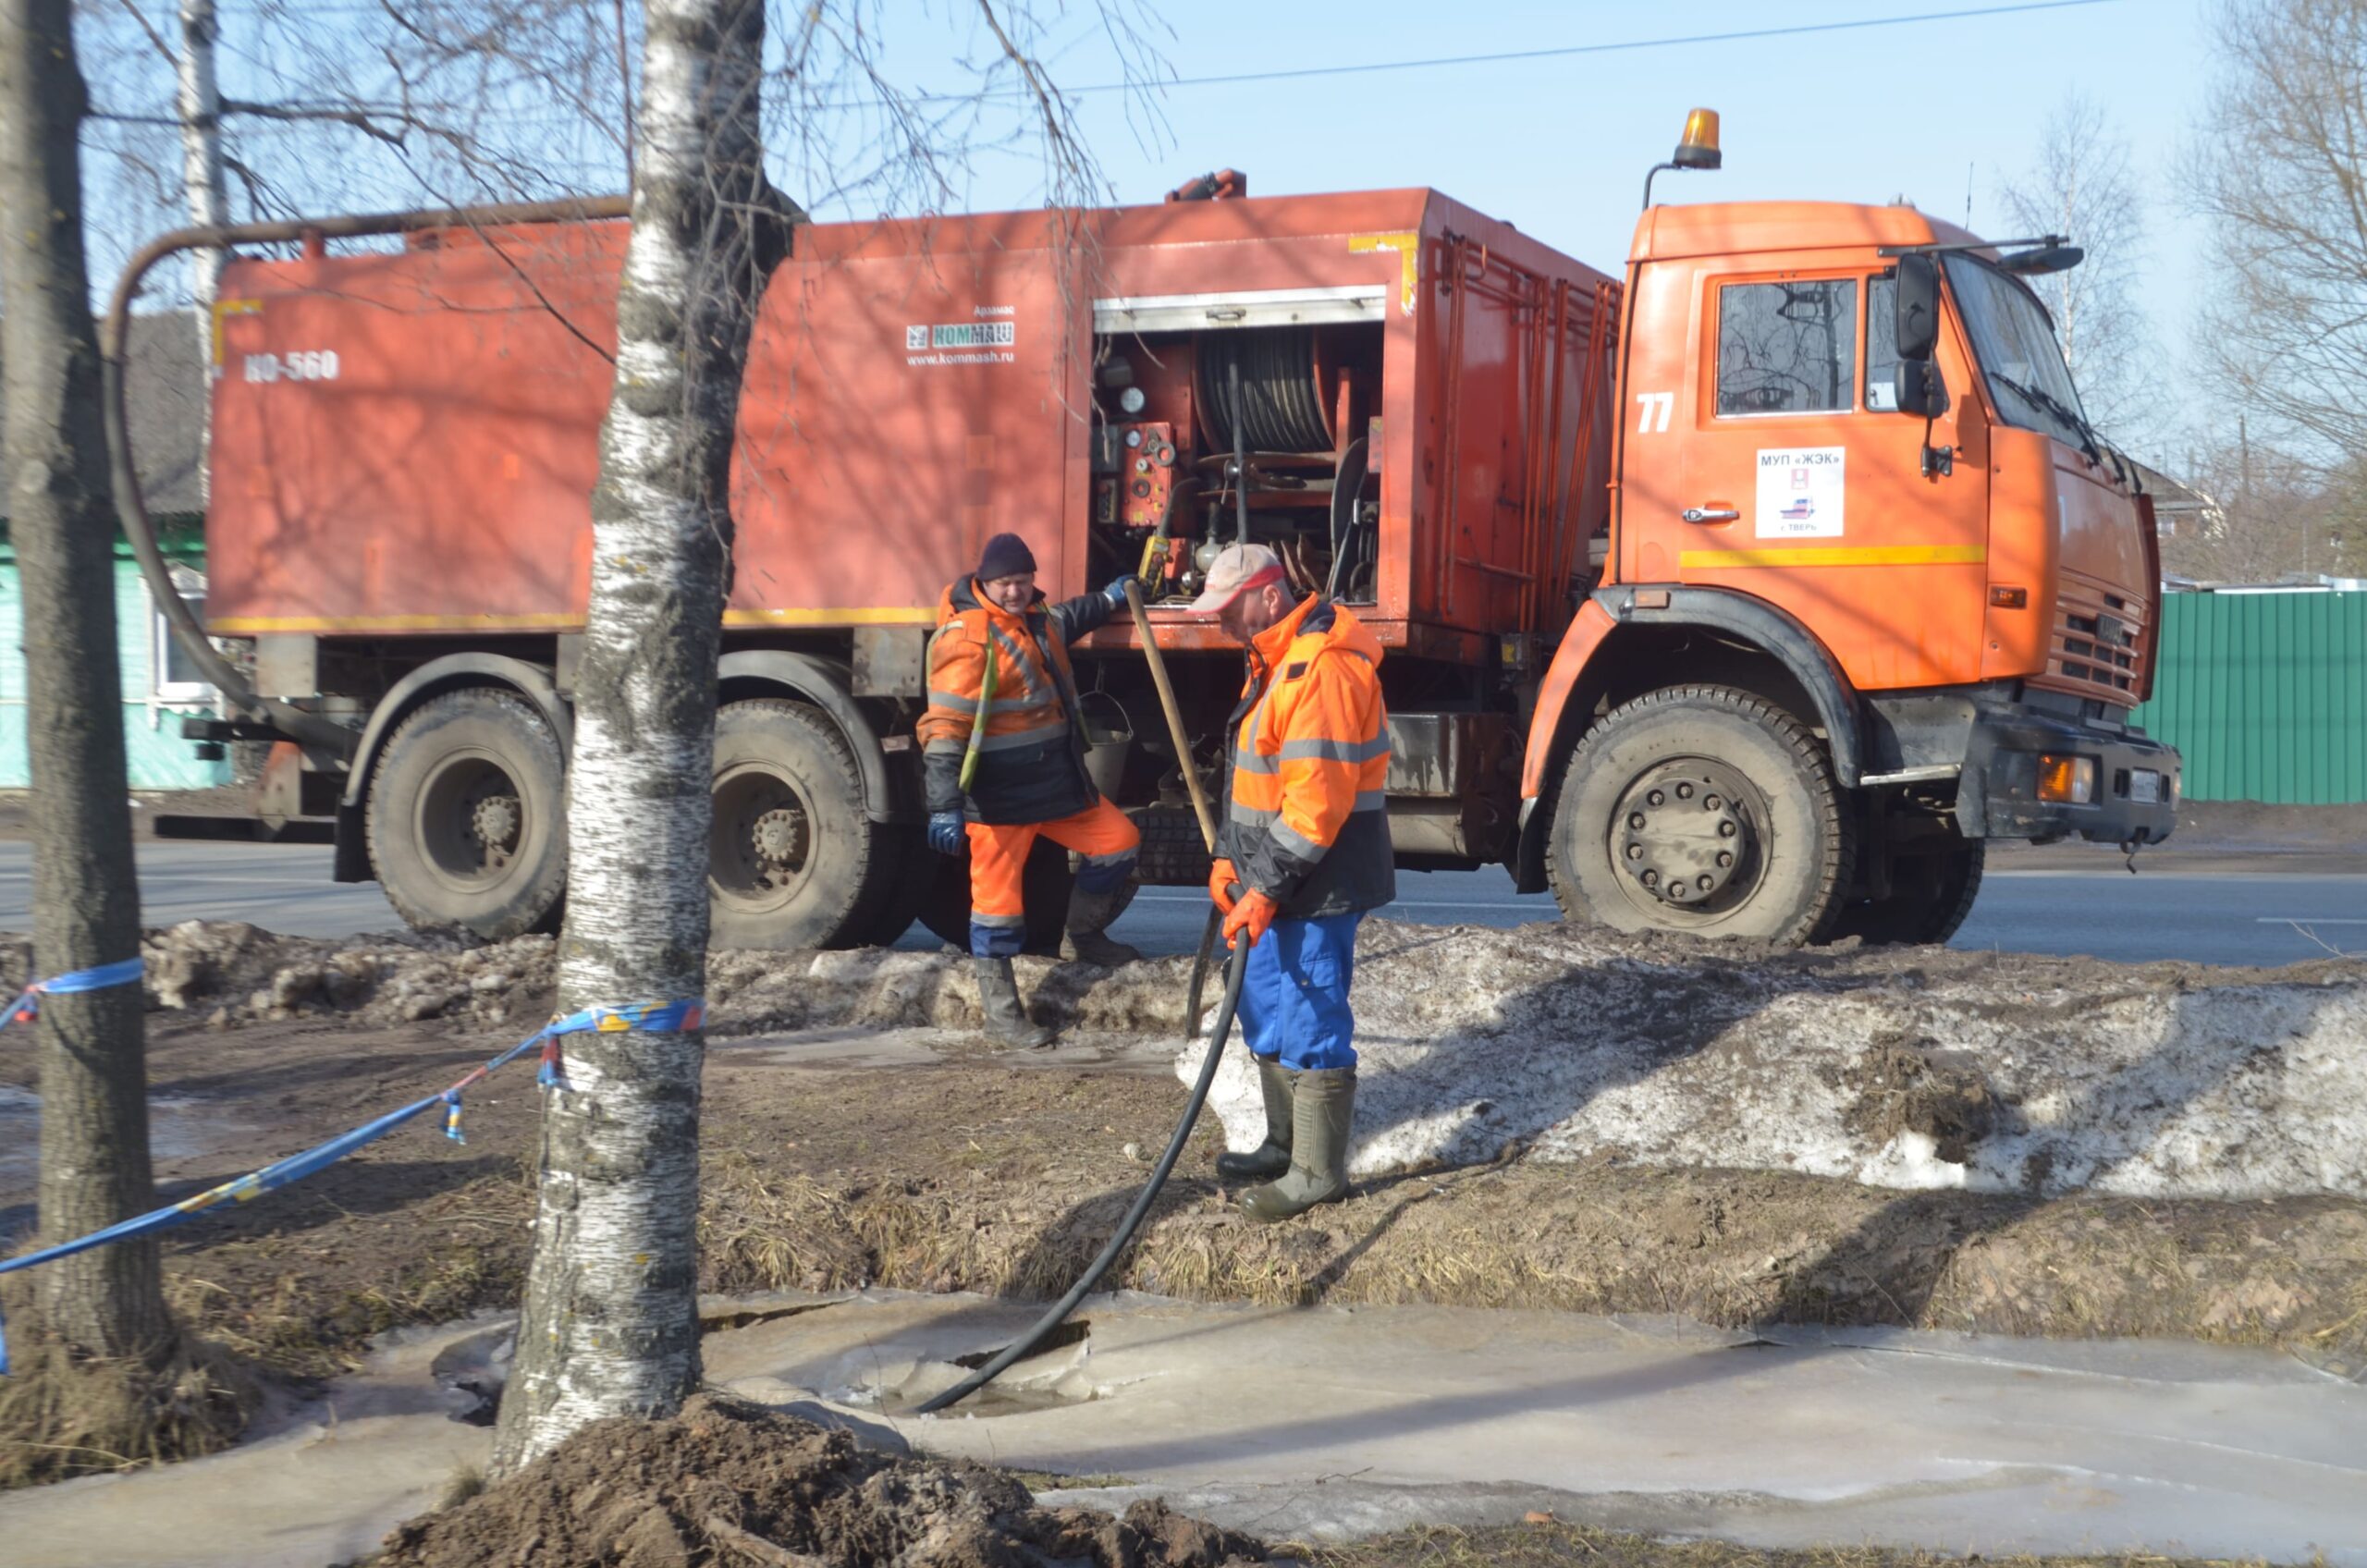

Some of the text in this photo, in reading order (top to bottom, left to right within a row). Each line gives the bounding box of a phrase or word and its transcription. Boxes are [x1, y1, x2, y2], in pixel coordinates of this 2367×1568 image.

[906, 350, 1014, 366] www.kommash.ru
[1636, 391, 1674, 434] 77
[1760, 453, 1840, 466] МУП «ЖЭК»
